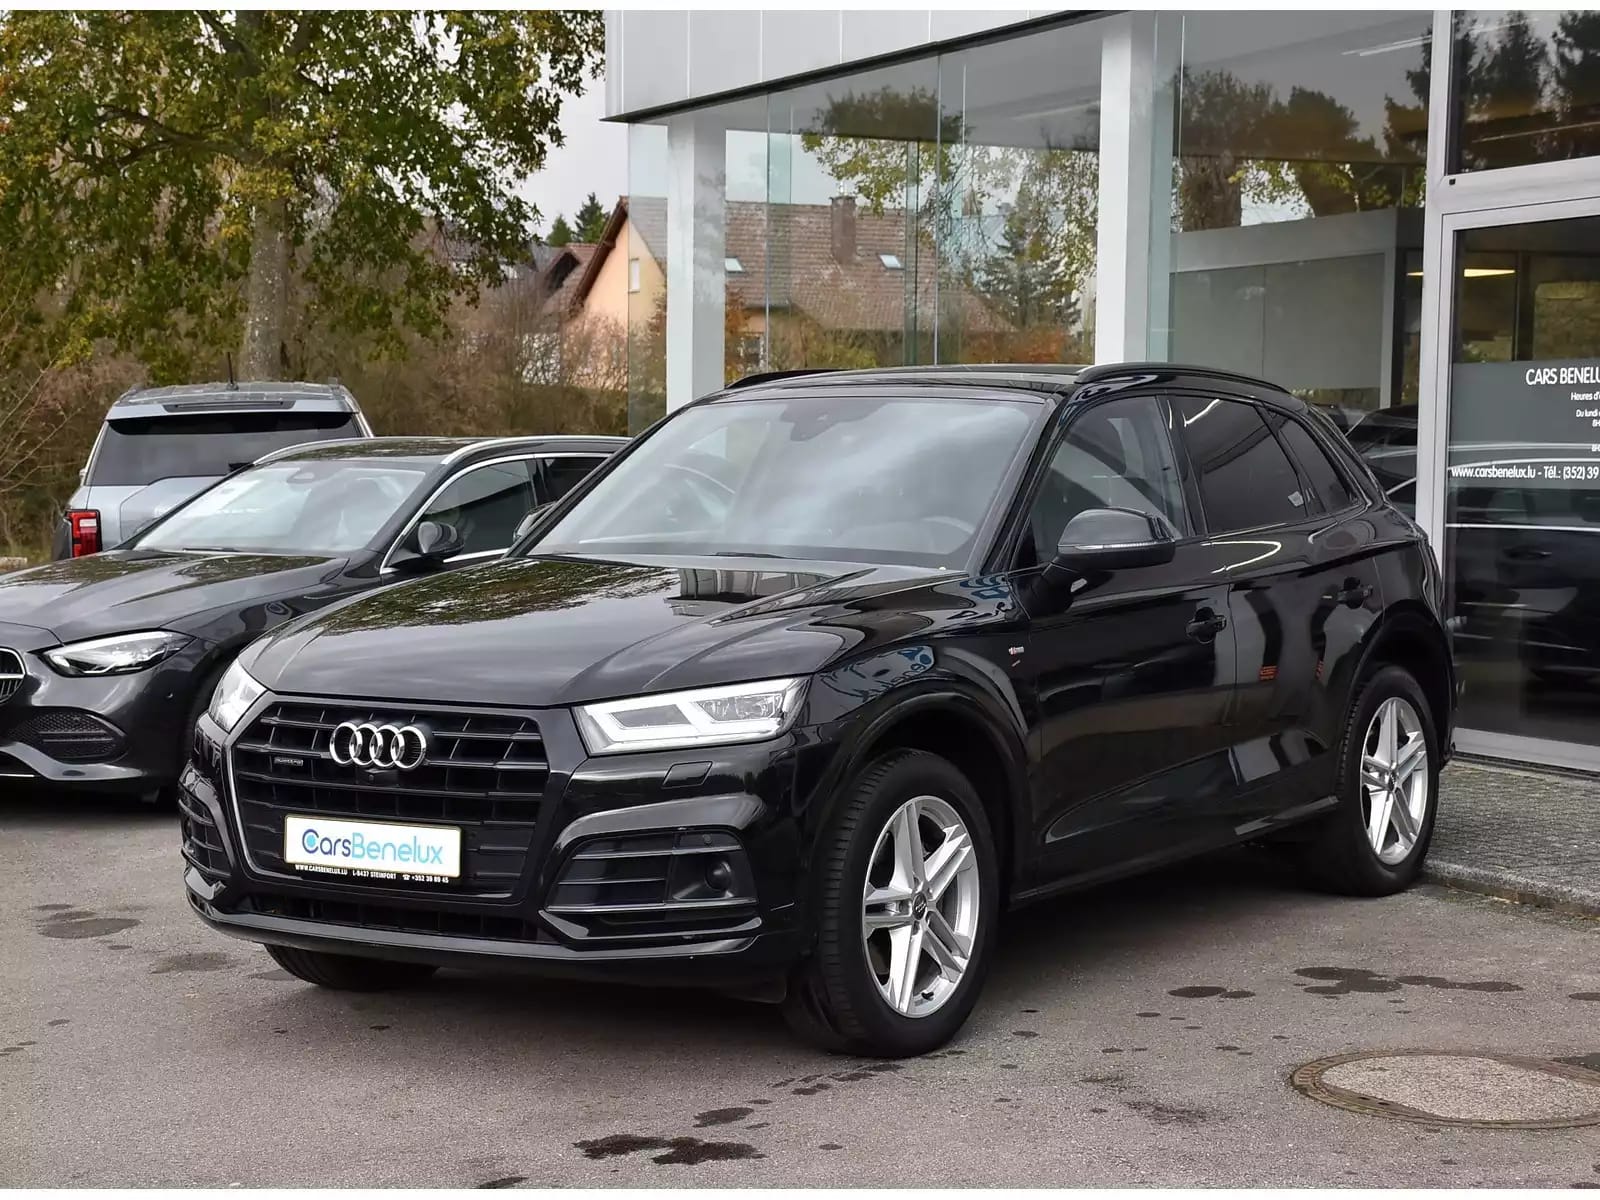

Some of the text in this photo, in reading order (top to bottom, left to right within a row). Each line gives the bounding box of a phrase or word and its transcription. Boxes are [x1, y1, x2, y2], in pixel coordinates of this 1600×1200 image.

[1525, 368, 1558, 385] CARS
[1570, 392, 1593, 401] Heures
[1451, 465, 1536, 479] www.carsbenelux.lu
[1563, 465, 1586, 480] (352)
[1586, 466, 1600, 480] 39
